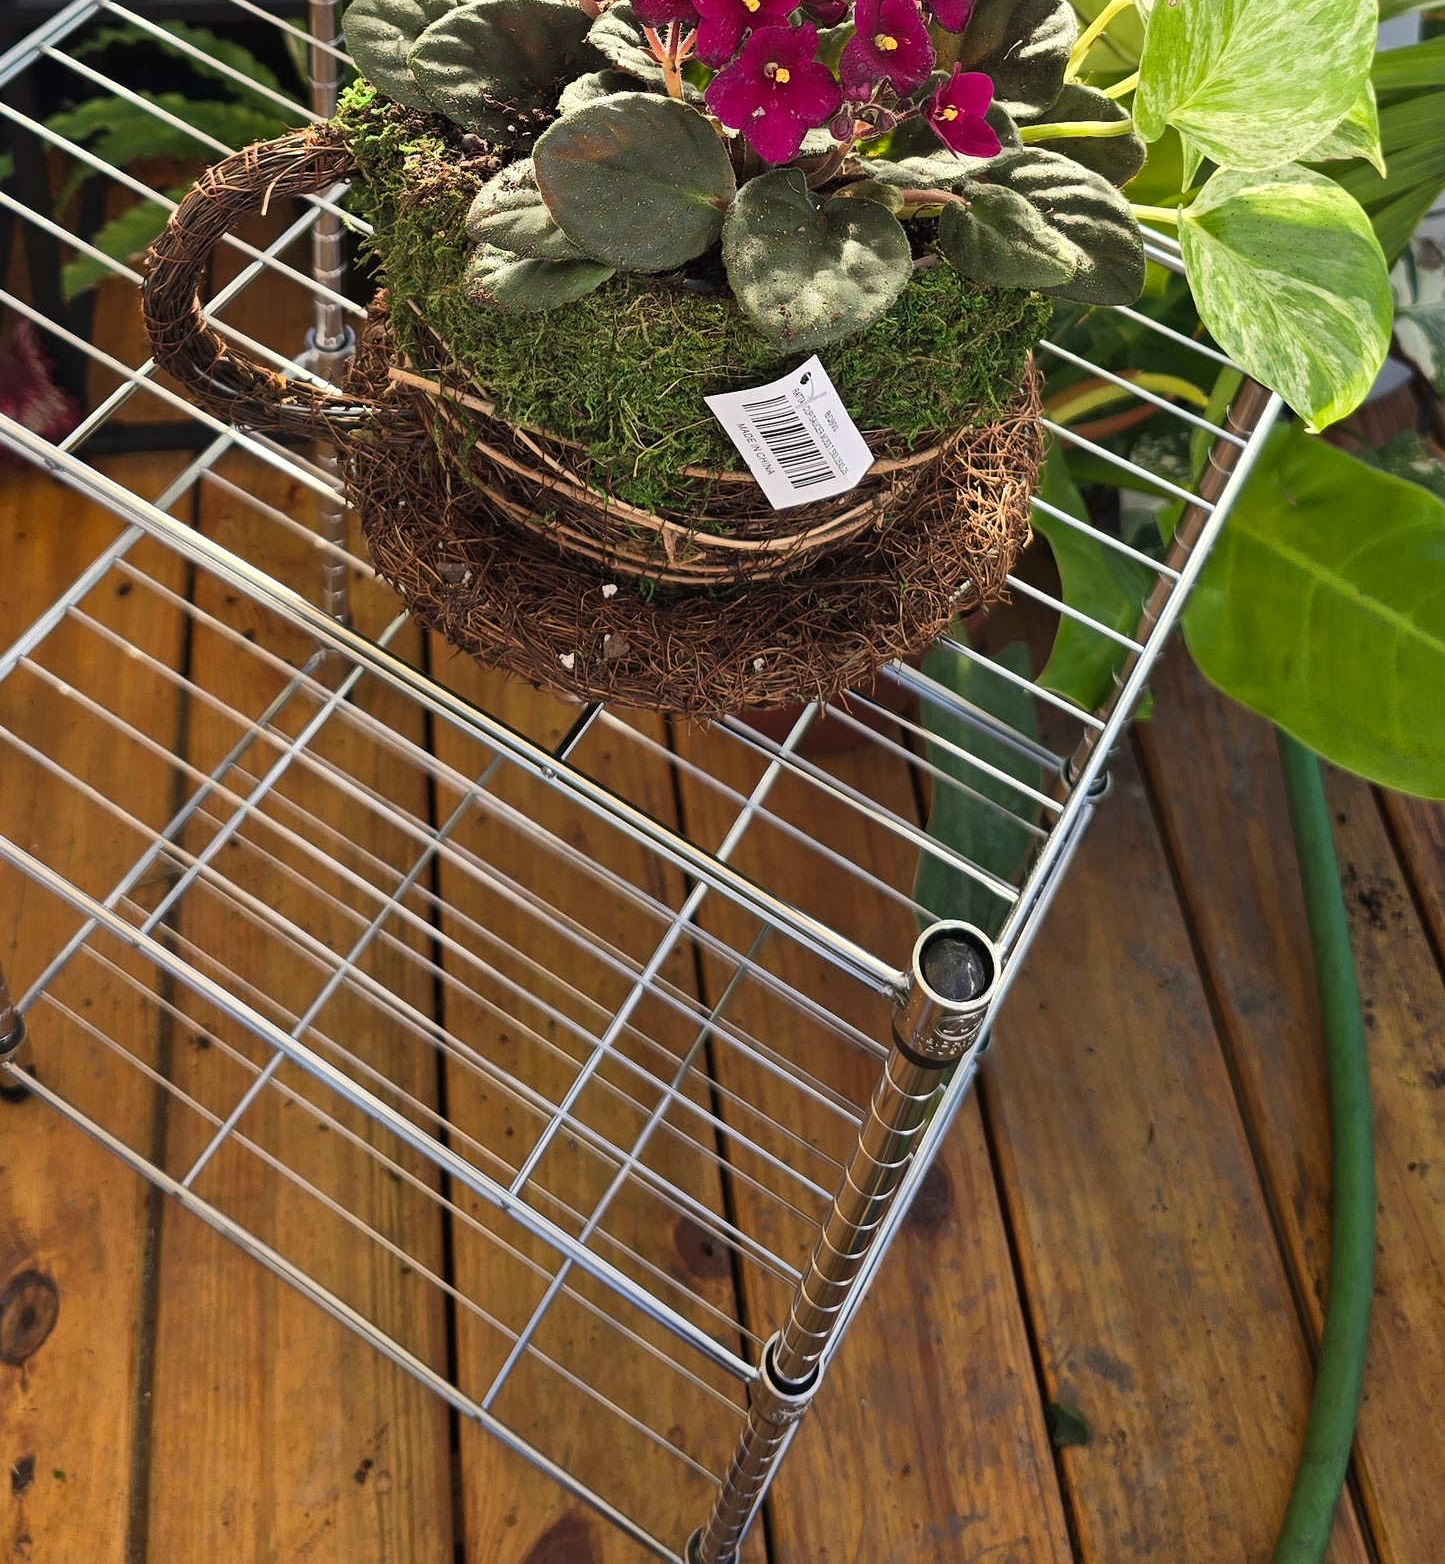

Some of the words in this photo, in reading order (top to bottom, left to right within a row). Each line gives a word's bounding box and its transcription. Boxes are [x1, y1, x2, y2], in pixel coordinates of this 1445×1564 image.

[737, 423, 756, 446] MADE
[750, 444, 760, 454] IN
[756, 453, 775, 475] CHINA
